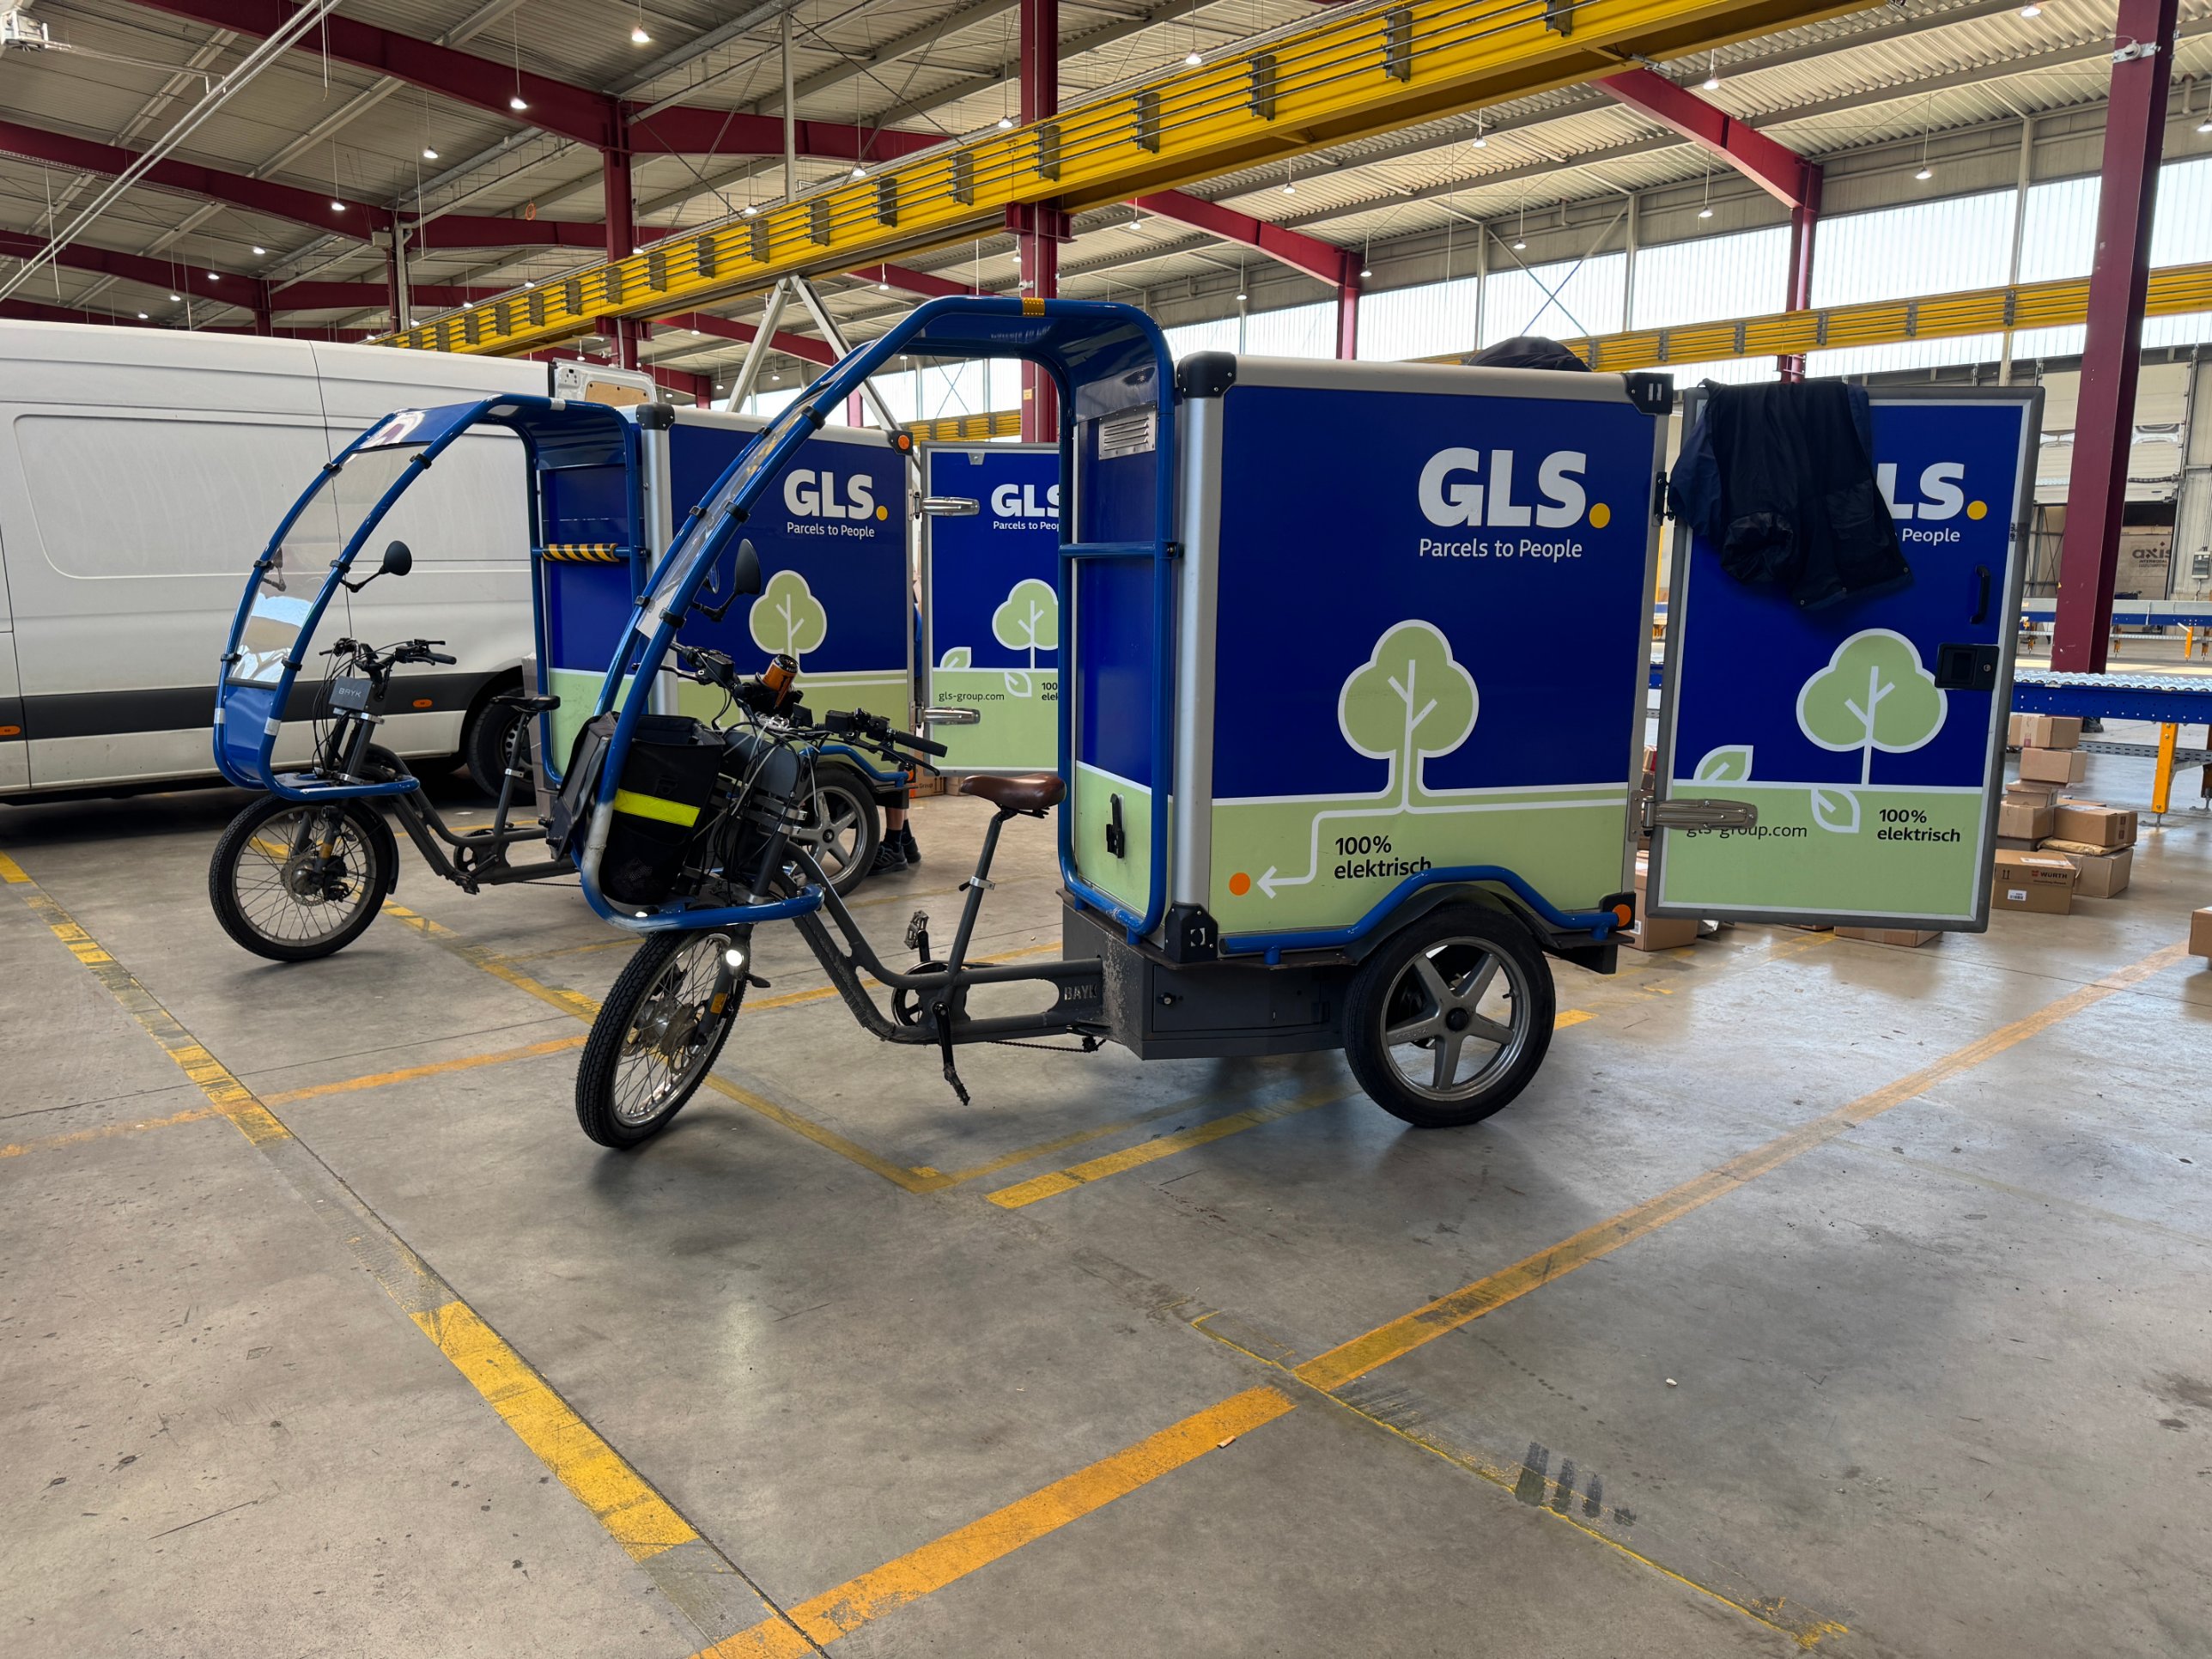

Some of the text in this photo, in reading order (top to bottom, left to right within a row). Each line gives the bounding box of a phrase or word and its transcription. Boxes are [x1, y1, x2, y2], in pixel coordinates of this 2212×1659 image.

[1876, 462, 1988, 520] LS.
[787, 521, 875, 540] Parcels to People
[993, 520, 1026, 530] Parcels
[1028, 521, 1038, 530] to
[1902, 527, 1960, 546] People
[1419, 538, 1583, 563] Parcels to People
[338, 687, 362, 698] BAYK
[1041, 682, 1058, 690] 100
[939, 691, 1005, 702] gls-group.com
[1879, 809, 1927, 823] 100%
[1877, 826, 1960, 842] elektrisch
[1334, 835, 1392, 856] 100%
[1334, 856, 1432, 879] elektrisch
